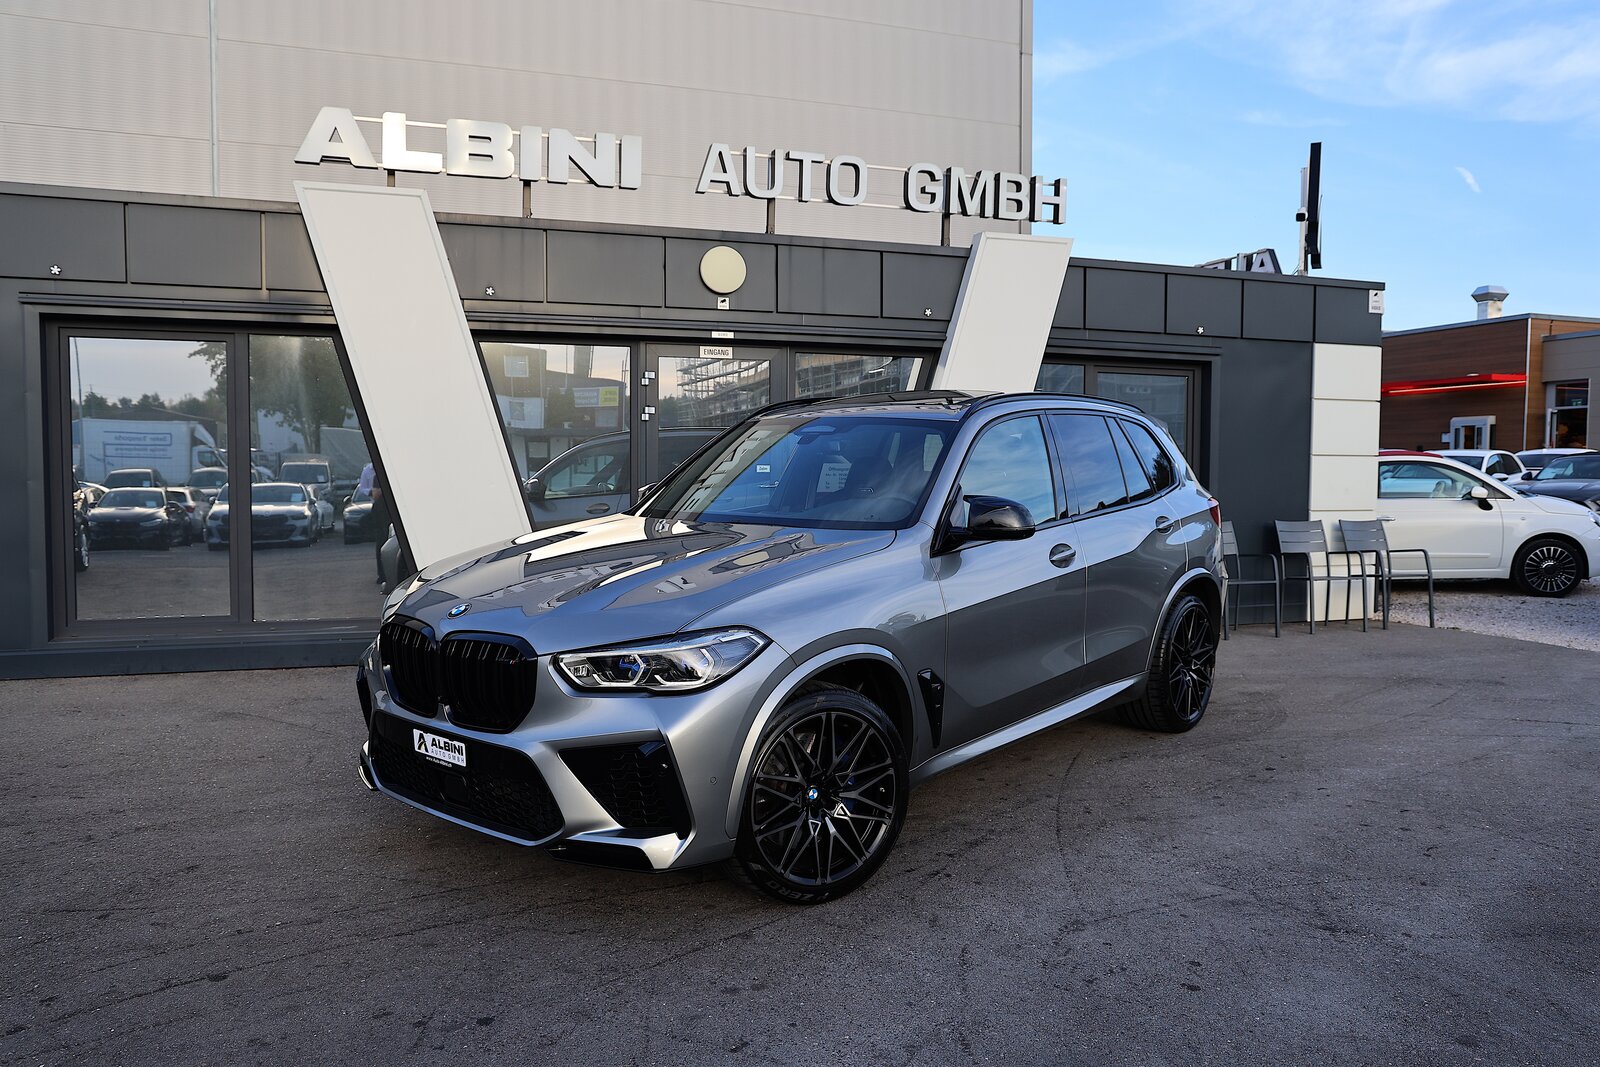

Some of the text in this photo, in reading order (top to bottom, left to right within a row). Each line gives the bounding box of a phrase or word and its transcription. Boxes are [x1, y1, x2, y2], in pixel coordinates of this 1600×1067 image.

[294, 106, 1067, 224] ALBINI AUTO GMBH
[703, 348, 729, 357] EINGANG
[431, 737, 463, 756] ALBINI
[431, 748, 446, 757] AUTO
